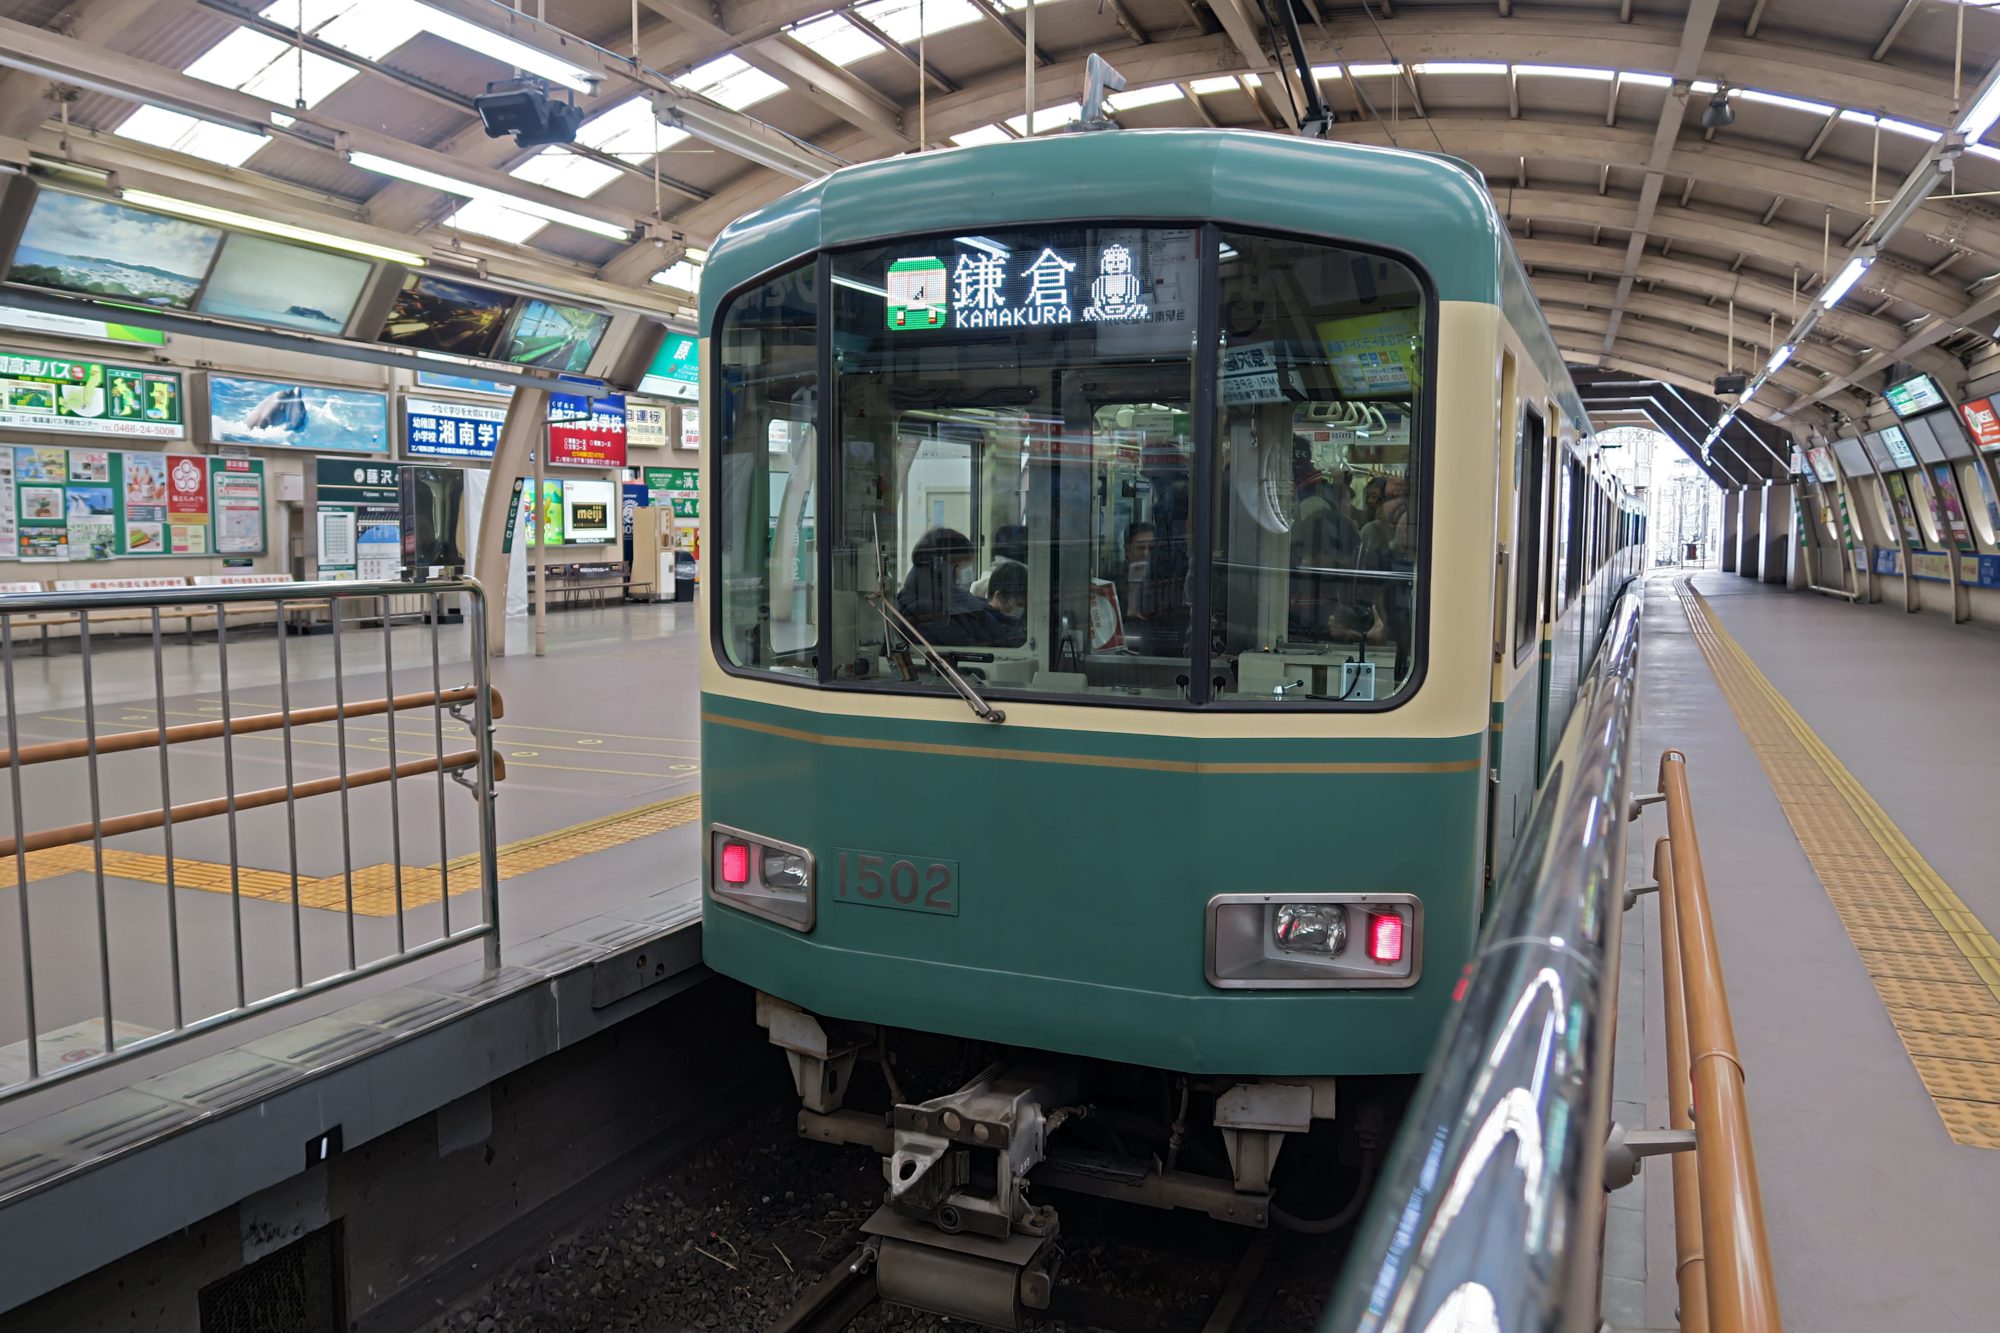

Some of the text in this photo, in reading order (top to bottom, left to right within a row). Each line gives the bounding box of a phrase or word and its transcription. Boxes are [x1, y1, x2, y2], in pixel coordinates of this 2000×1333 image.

[952, 248, 1077, 309] 鎌倉
[955, 305, 1072, 328] KAMAKURA
[366, 468, 392, 484] 藤沢
[576, 505, 603, 523] meiji
[838, 853, 952, 909] 1502
